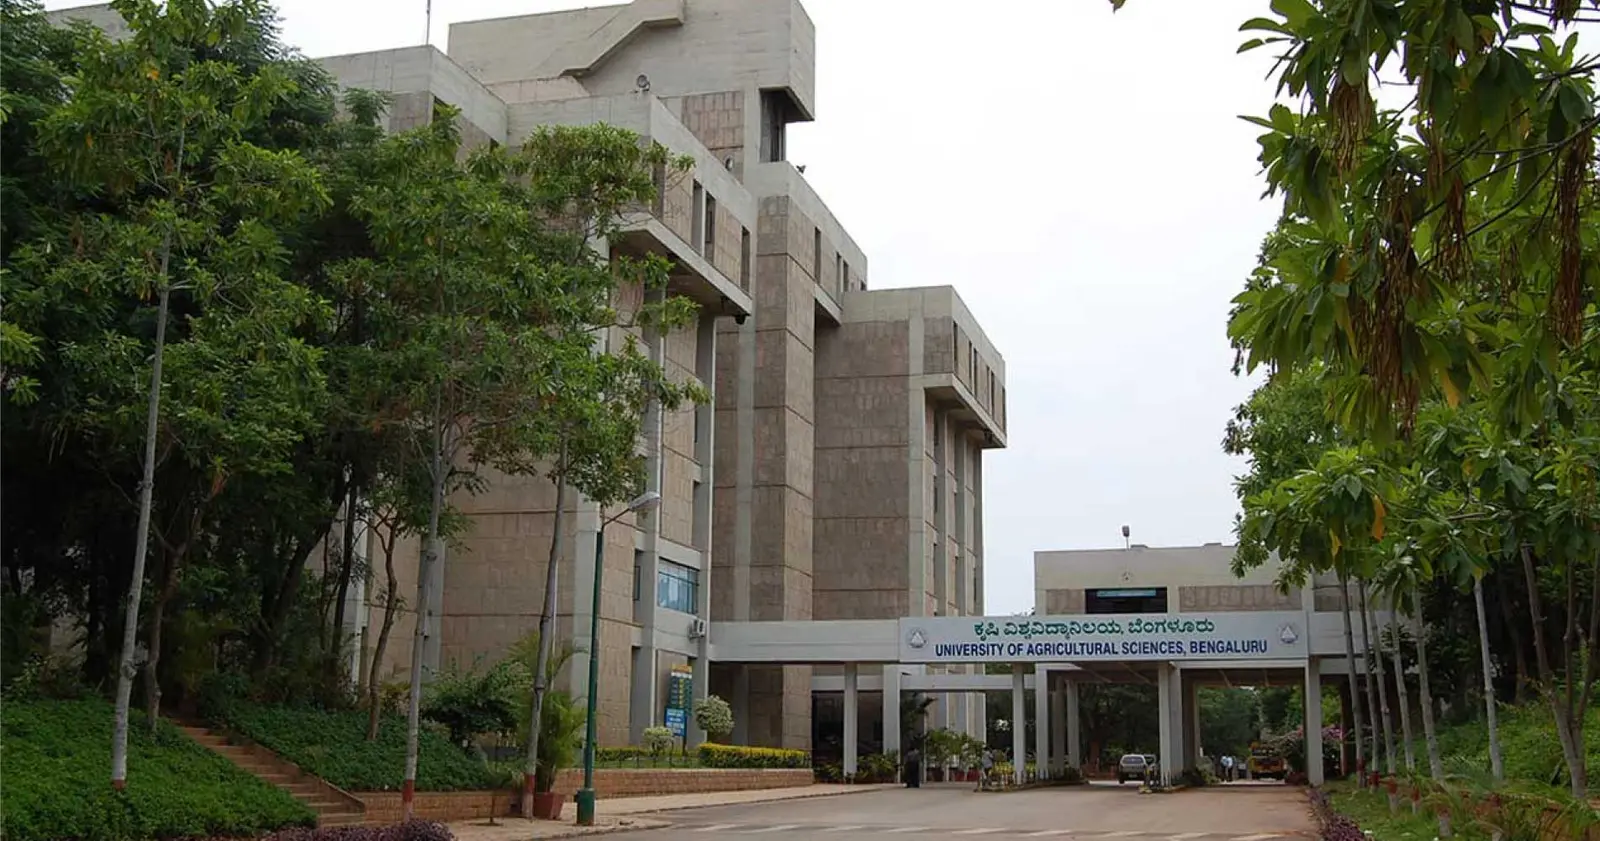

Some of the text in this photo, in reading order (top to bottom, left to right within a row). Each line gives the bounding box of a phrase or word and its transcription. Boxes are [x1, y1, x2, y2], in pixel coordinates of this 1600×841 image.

[974, 621, 999, 641] ಕೃಷಿ
[1128, 617, 1215, 634] ಬೆಂಗಳೂರು
[935, 640, 1268, 657] UNIVERSITY OF AGRICULTURAL SCIENCES, BENGALURU
